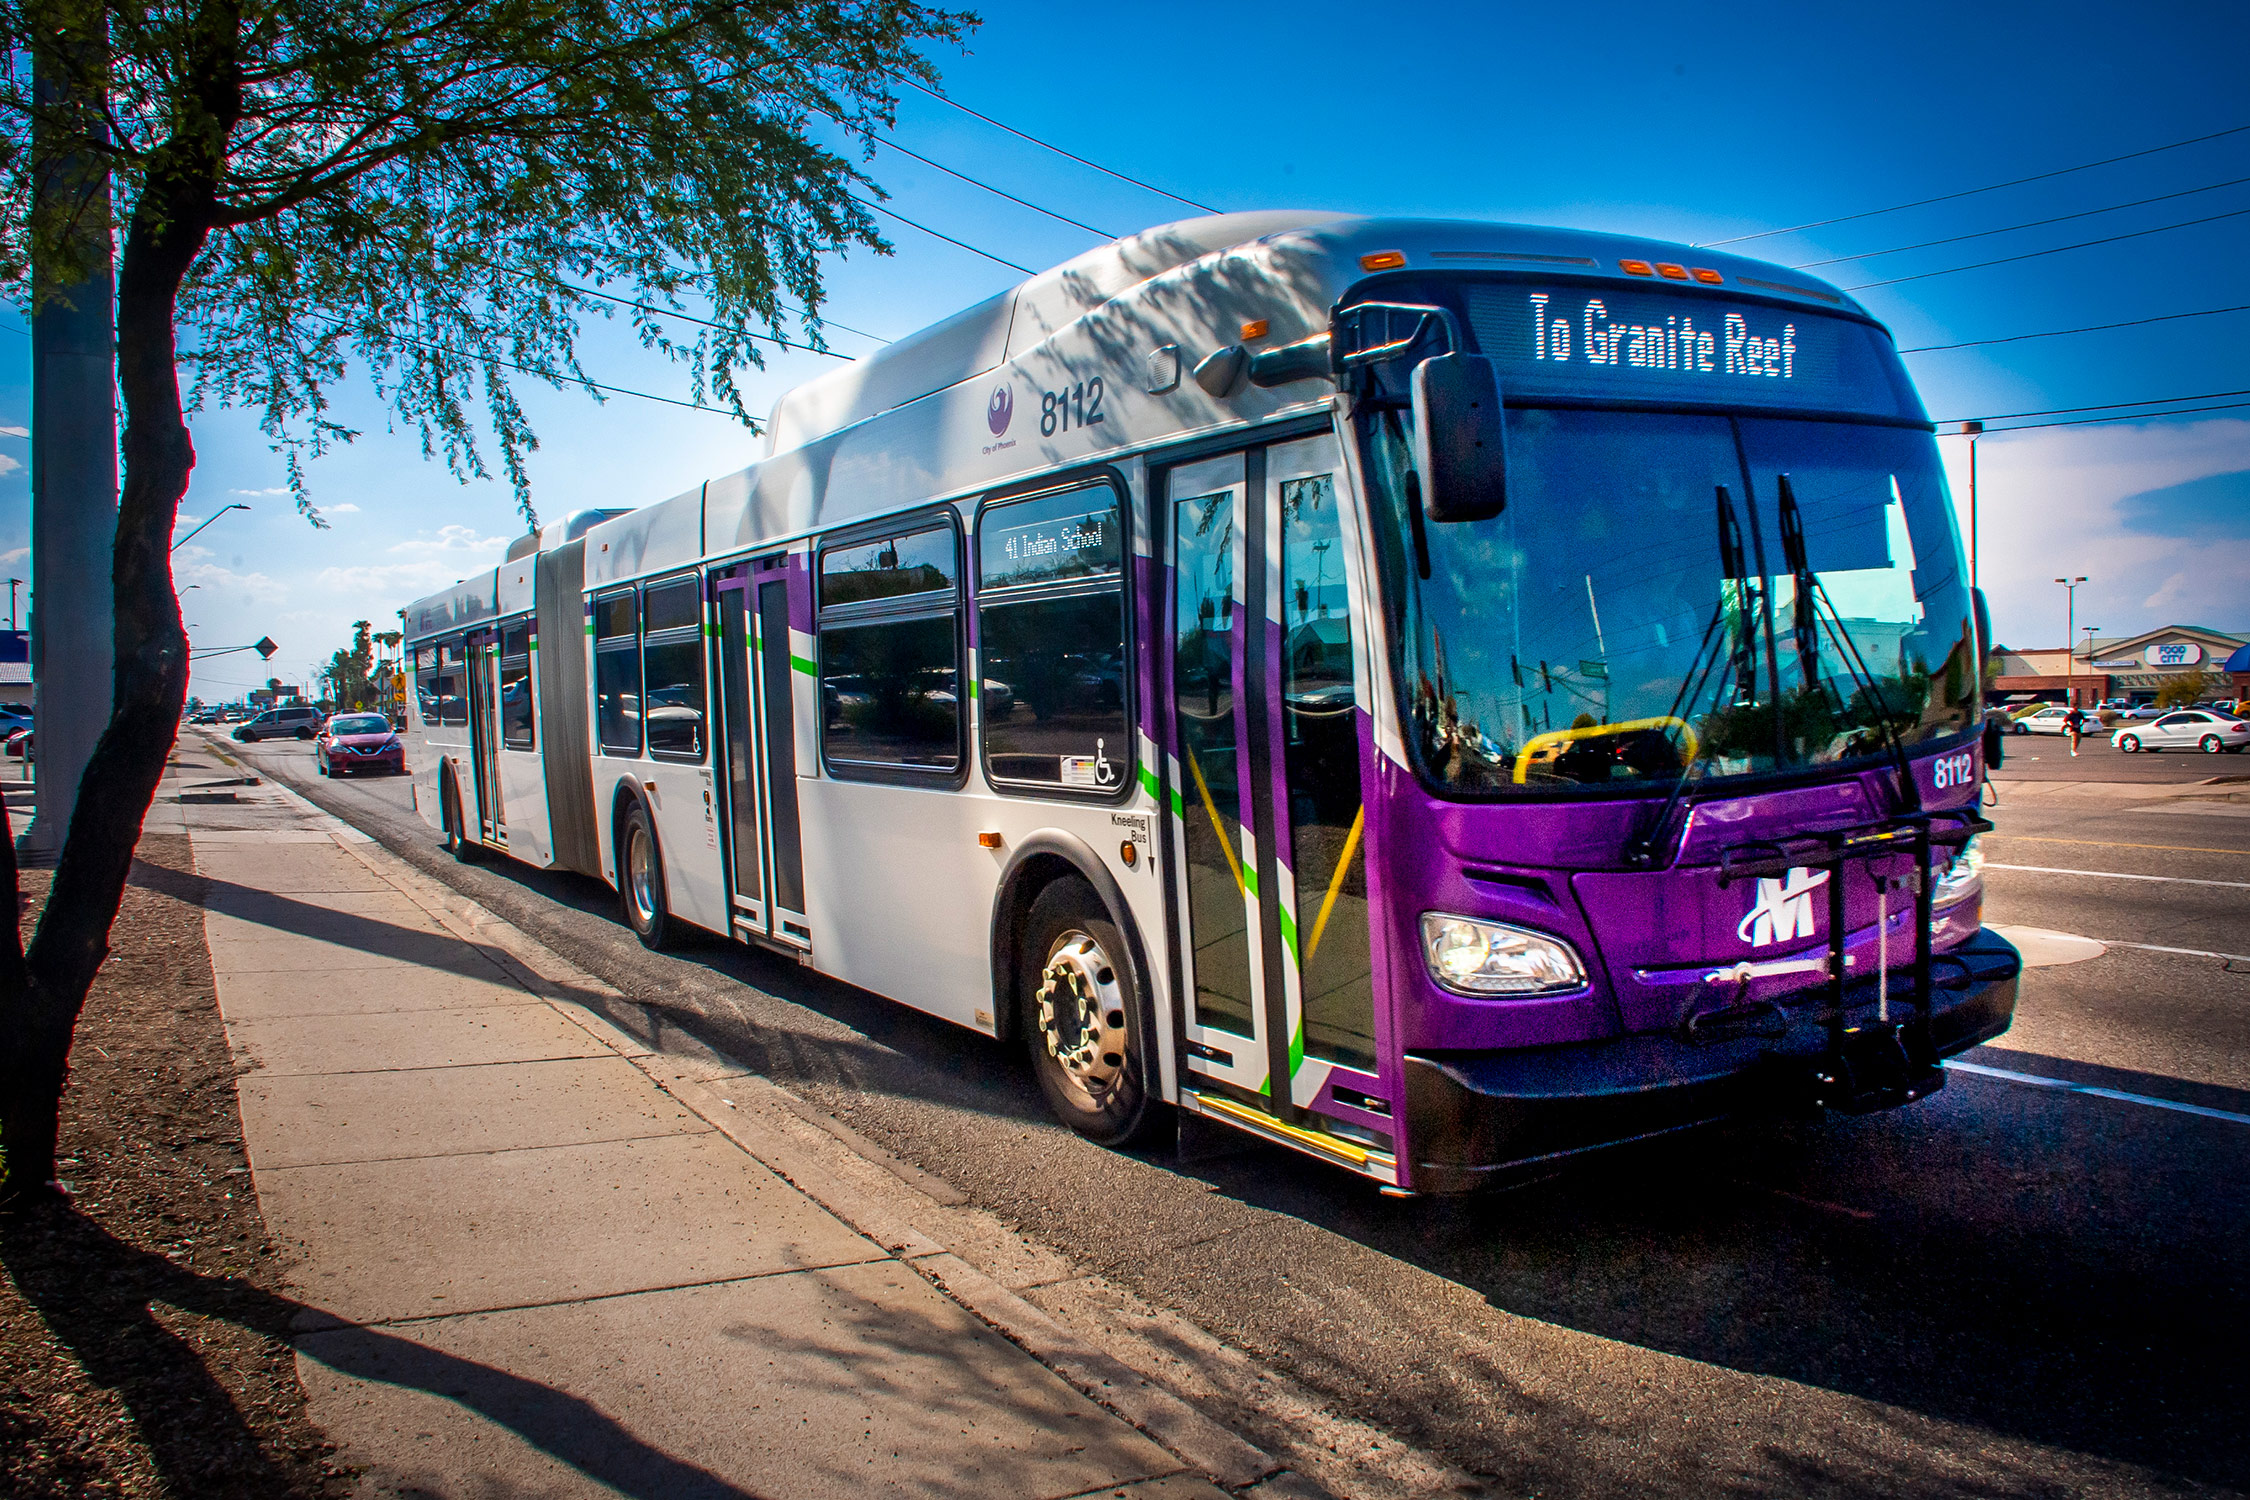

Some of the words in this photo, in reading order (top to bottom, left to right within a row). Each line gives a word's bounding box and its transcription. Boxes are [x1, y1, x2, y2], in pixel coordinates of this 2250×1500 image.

[1530, 293, 1570, 361] To
[1584, 299, 1715, 372] Granite
[1725, 312, 1796, 378] Reef
[1040, 376, 1104, 437] 8112
[1005, 537, 1018, 559] 41
[1022, 532, 1057, 557] Indian
[1061, 521, 1102, 551] School
[2158, 645, 2186, 655] FOOD
[2160, 654, 2184, 663] CITY
[1933, 753, 1972, 789] 8112
[1111, 813, 1146, 831] Kneeling
[1131, 830, 1147, 843] Bus
